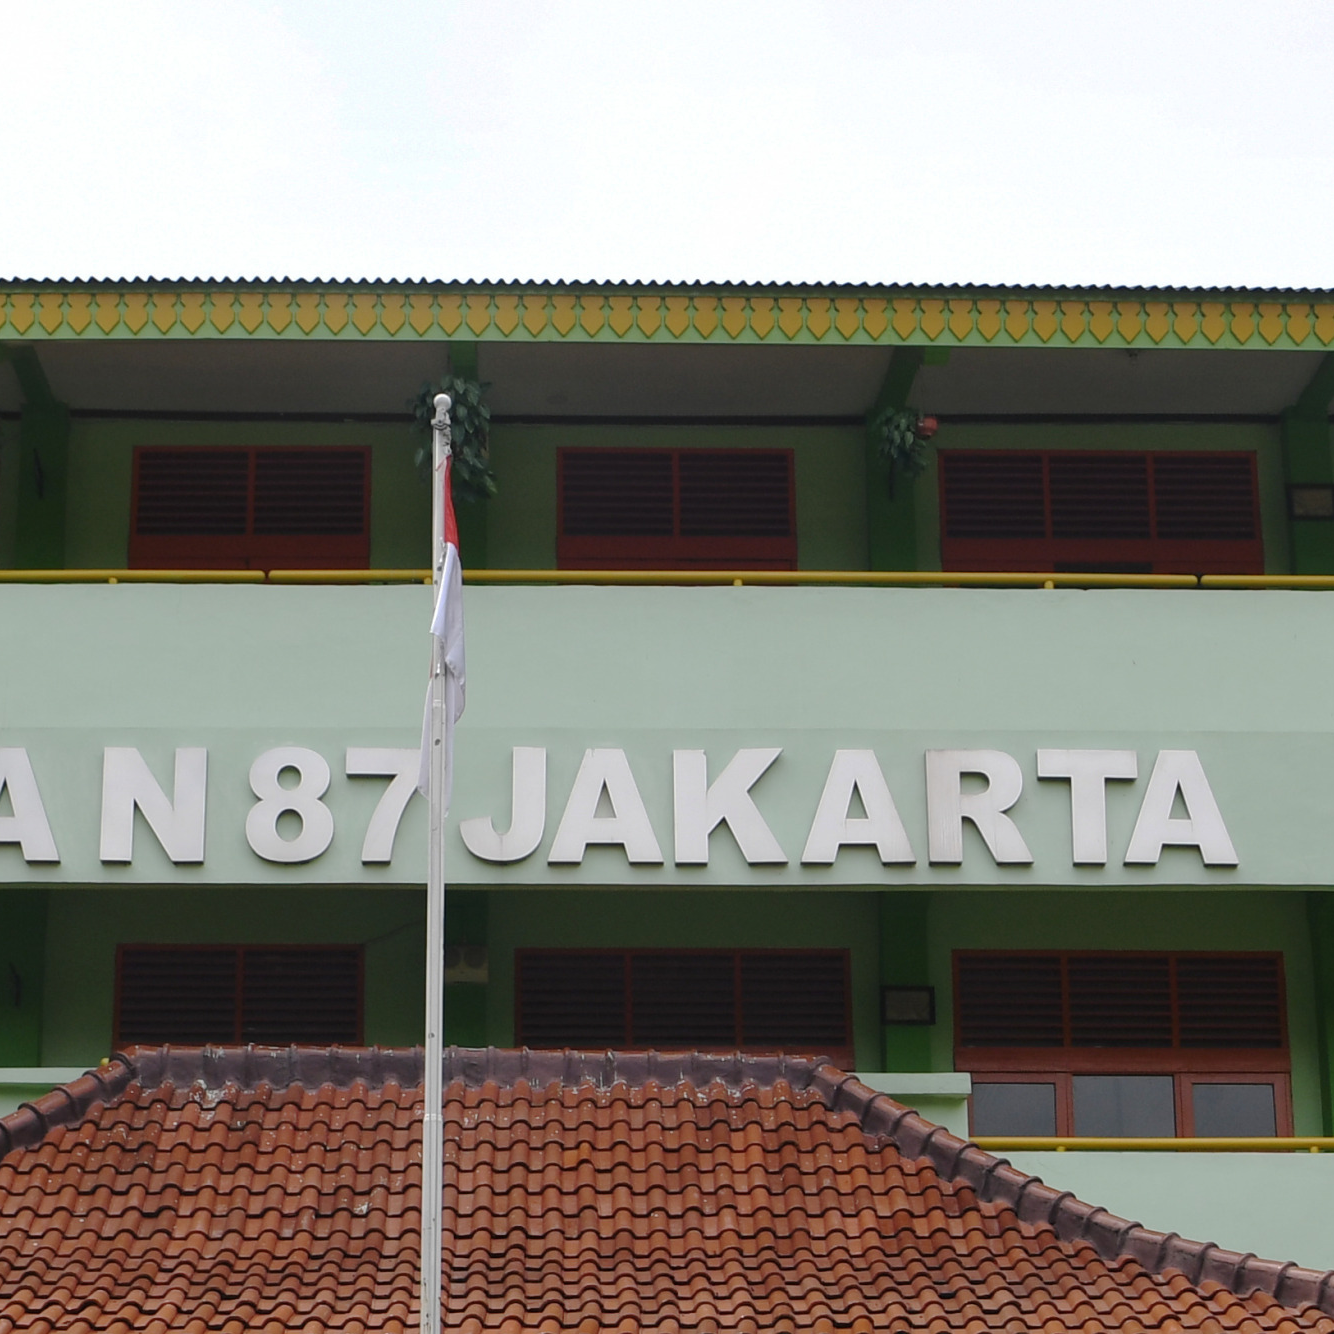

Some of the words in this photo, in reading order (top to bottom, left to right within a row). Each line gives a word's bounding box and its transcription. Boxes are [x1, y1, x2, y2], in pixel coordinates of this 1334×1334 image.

[99, 745, 209, 866] N
[245, 745, 423, 866] 87
[458, 745, 1240, 867] JAKARTA
